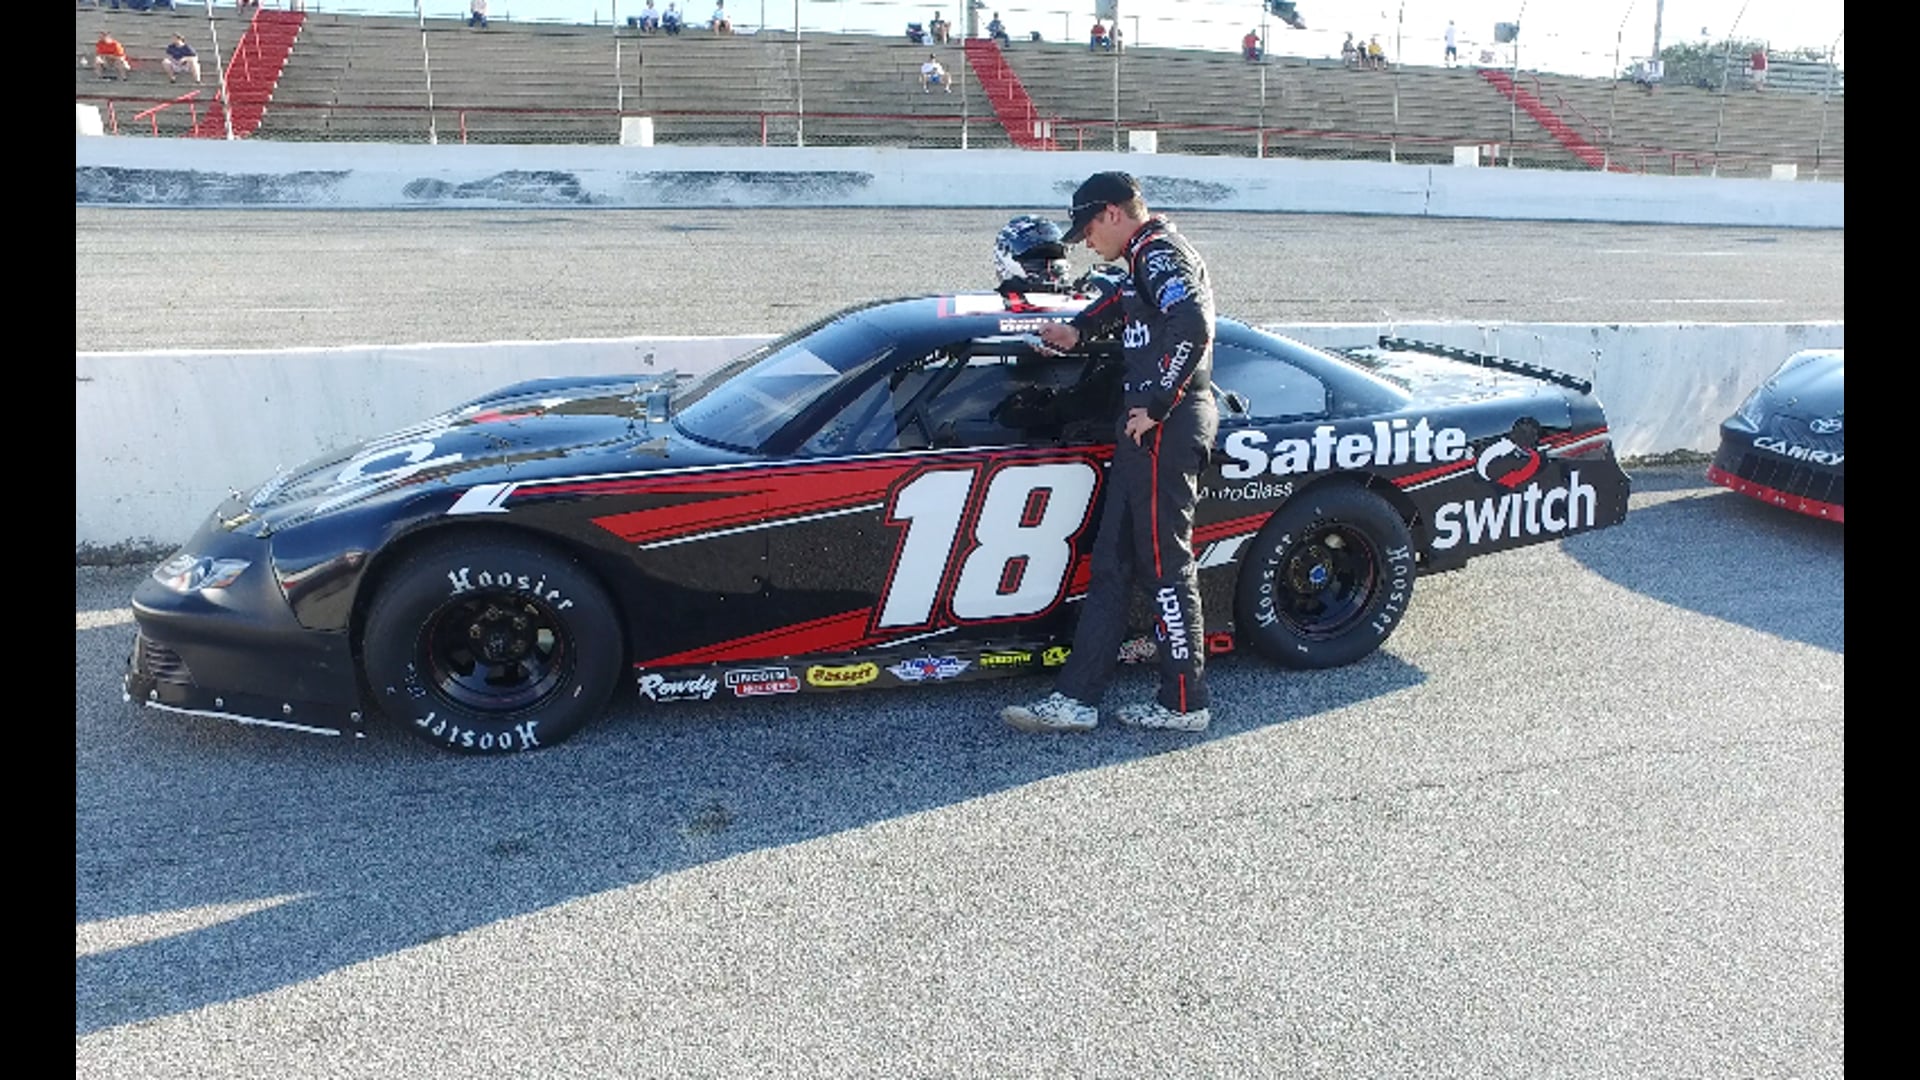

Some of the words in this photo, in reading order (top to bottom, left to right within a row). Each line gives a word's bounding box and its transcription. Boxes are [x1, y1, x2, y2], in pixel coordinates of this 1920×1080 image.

[1160, 340, 1193, 391] switch
[1221, 417, 1468, 480] Safelite
[1753, 436, 1844, 465] CAMRY
[1199, 481, 1293, 501] AutoGlass
[1432, 470, 1597, 550] switch
[878, 463, 1097, 628] 18
[447, 567, 573, 610] Hoosier
[1254, 533, 1293, 628] Hoosier
[1372, 544, 1410, 634] Hoosier
[1156, 586, 1189, 660] switch
[637, 673, 719, 700] Rowdy
[729, 671, 785, 684] LINCOLN
[416, 711, 542, 750] Hoosier
